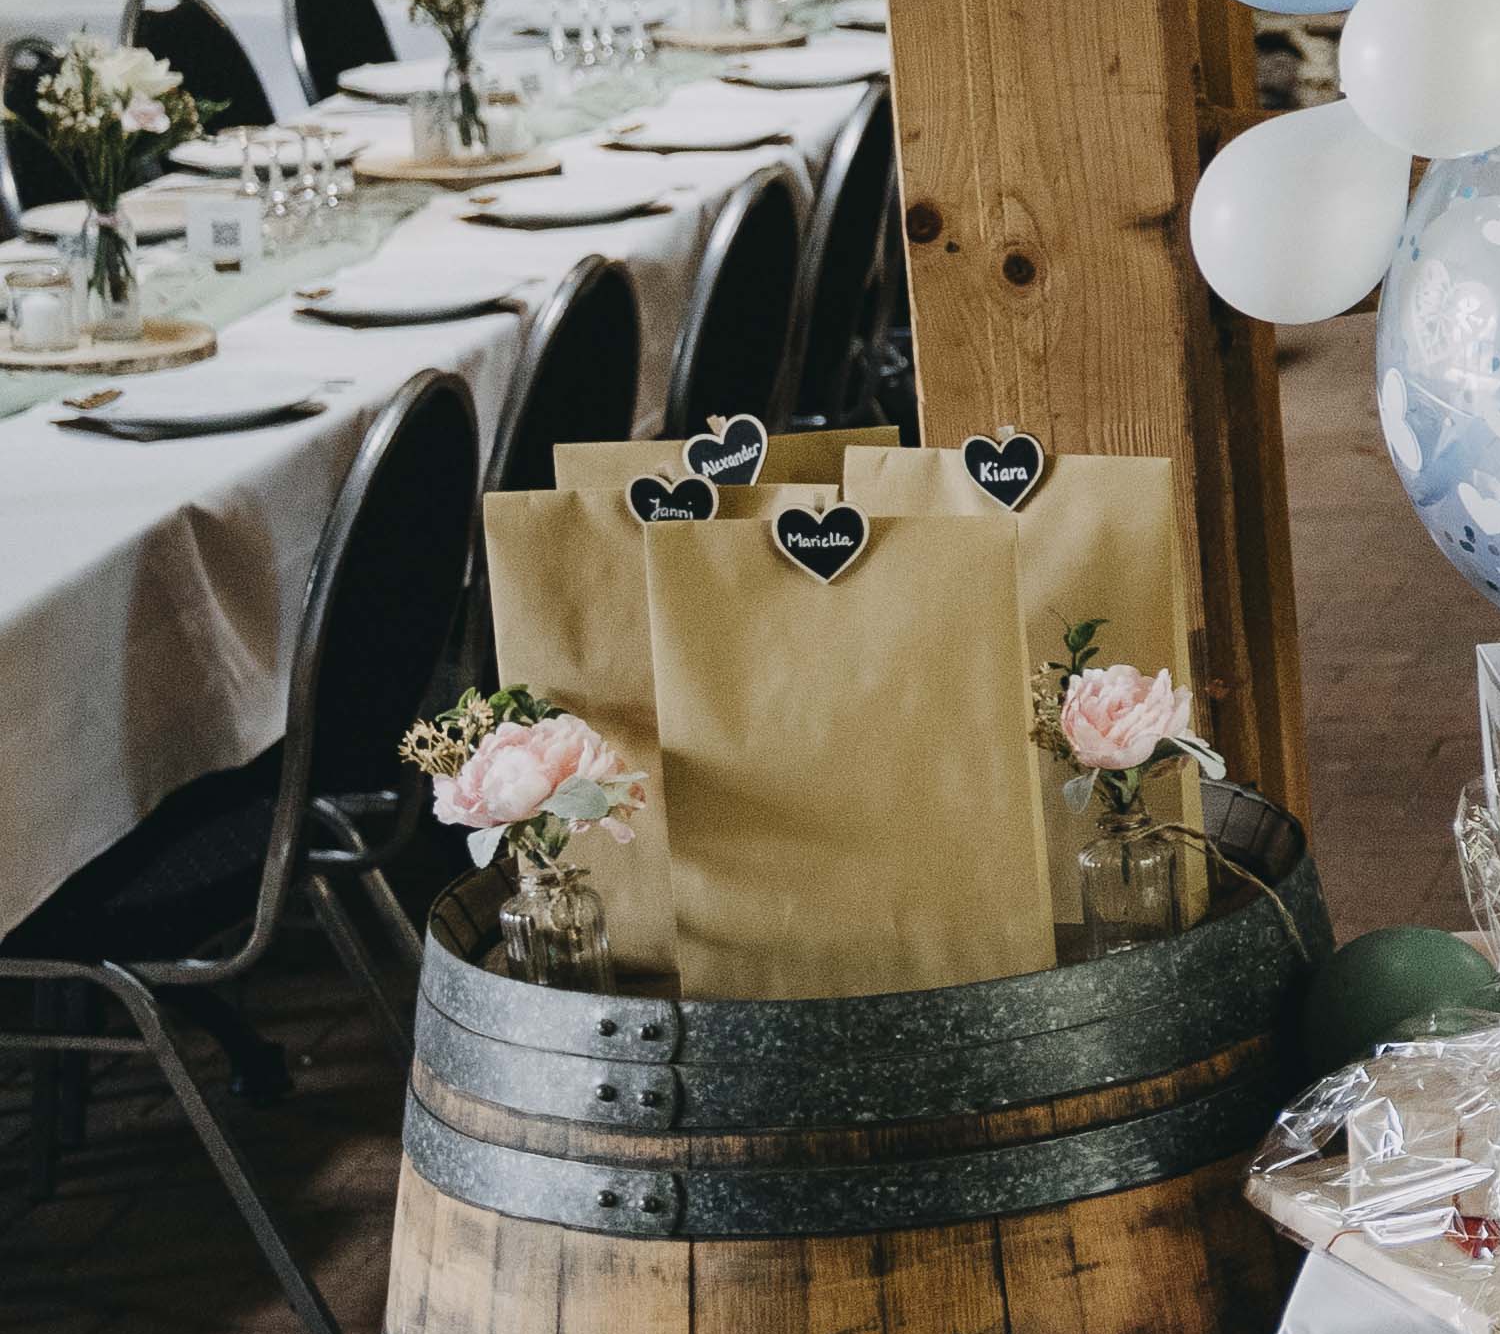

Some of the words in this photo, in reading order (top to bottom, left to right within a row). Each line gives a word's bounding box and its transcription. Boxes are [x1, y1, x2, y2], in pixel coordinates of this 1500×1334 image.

[701, 443, 761, 477] Alexander
[978, 460, 1029, 483] Kiara
[648, 497, 694, 521] Janni
[786, 531, 855, 549] Mariella
